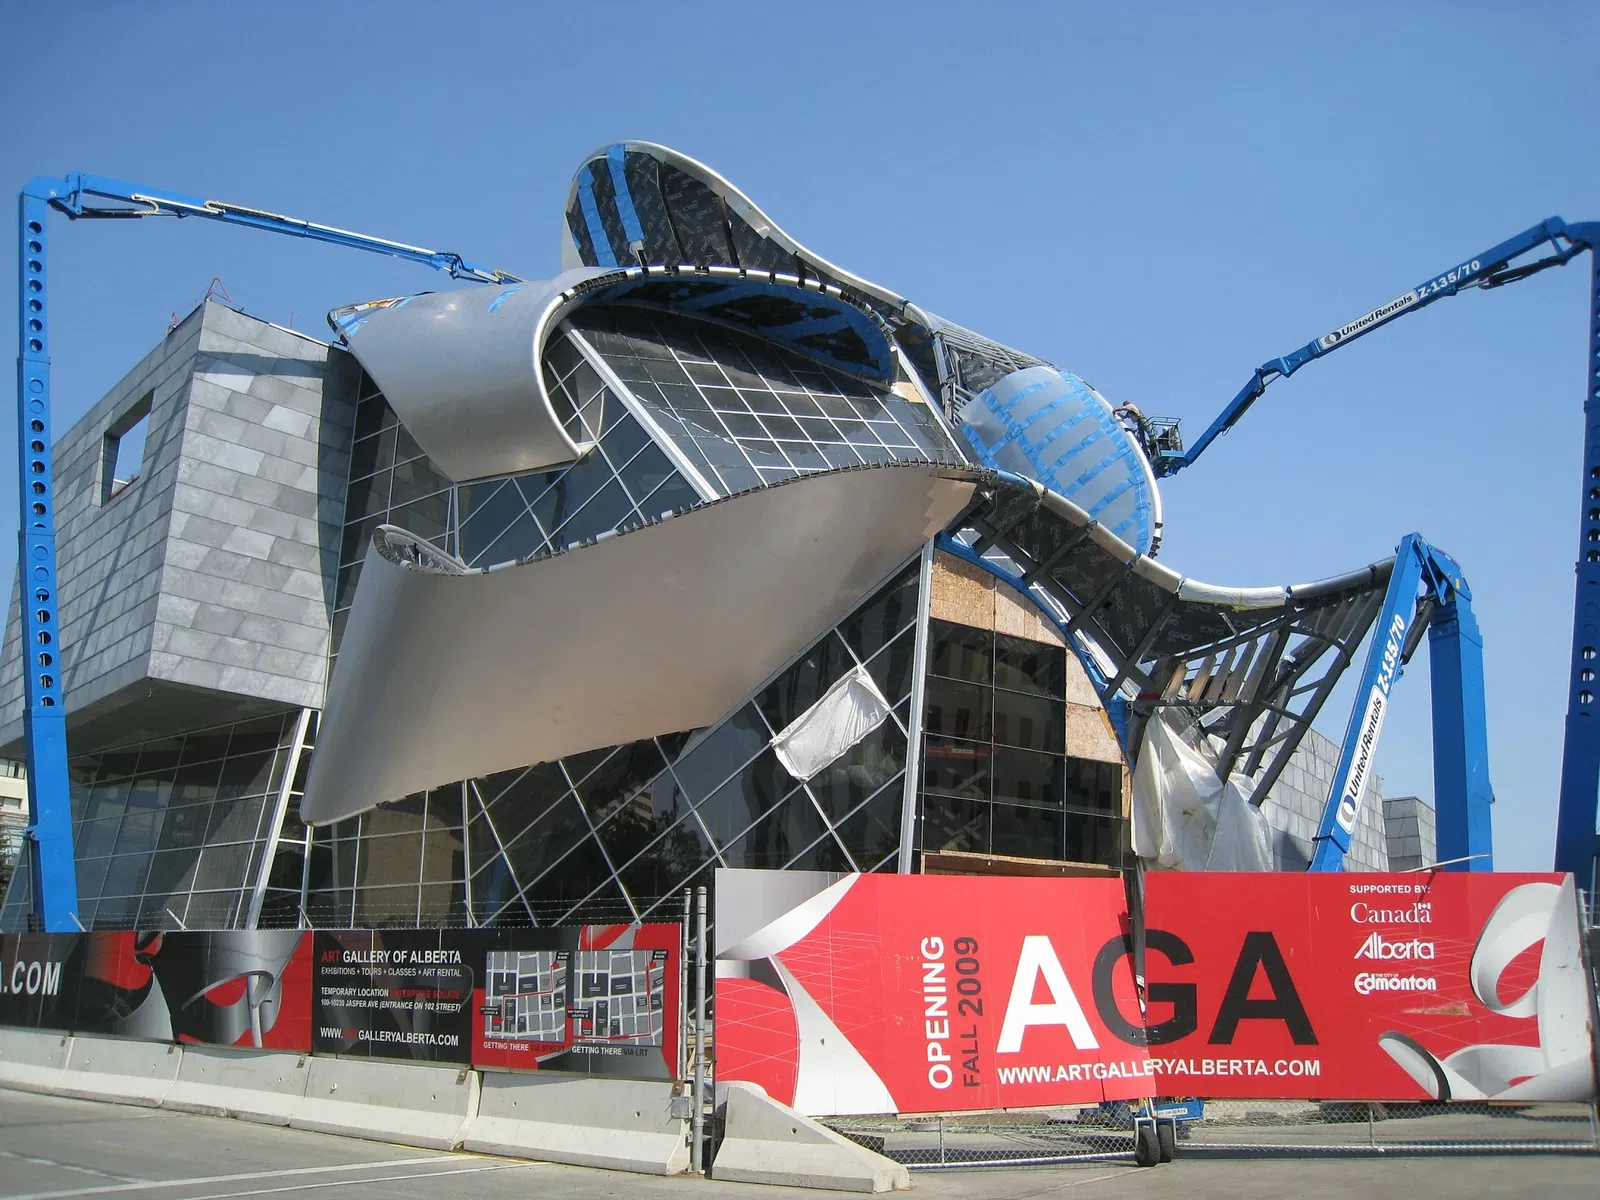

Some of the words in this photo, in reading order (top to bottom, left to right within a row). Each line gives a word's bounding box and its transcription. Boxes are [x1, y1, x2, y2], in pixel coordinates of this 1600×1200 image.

[1341, 310, 1375, 337] United
[1375, 293, 1413, 319] Rentals
[1417, 259, 1481, 299] Z-135/70
[1350, 745, 1369, 796] United
[1362, 697, 1382, 749] Rentals
[1376, 613, 1406, 695] Z-135/70
[1349, 884, 1411, 894] SUPPORTED
[1414, 884, 1431, 894] BY:
[1350, 902, 1432, 924] Canada
[1353, 931, 1435, 960] Alberta
[321, 950, 341, 963] ART
[343, 950, 391, 963] GALLERY
[393, 950, 408, 963] OF
[410, 950, 461, 964] ALBERTA
[321, 966, 355, 976] EXHIBITIONS
[362, 967, 382, 976] TOURS
[388, 968, 416, 976] CLASSES
[422, 968, 436, 976] ART
[437, 968, 461, 977] RENTAL
[953, 936, 983, 1017] 2009
[321, 987, 357, 996] TEMPORARY
[357, 988, 389, 997] LOCATION
[996, 929, 1319, 1053] AGA
[1354, 972, 1437, 995] Edmonton
[345, 999, 367, 1007] JASPER
[368, 1000, 379, 1008] AVE
[380, 1001, 413, 1009] (ENTRANCE
[414, 1002, 423, 1010] ON
[424, 1002, 434, 1010] 102
[920, 936, 953, 1089] OPENING
[320, 1026, 459, 1046] WWW.GALLERYALBERTA.COM
[483, 1041, 508, 1050] GETTING
[509, 1042, 529, 1051] THERE
[572, 1045, 599, 1055] GETTING
[601, 1046, 622, 1056] THERE
[624, 1048, 634, 1056] VIA
[635, 1048, 648, 1057] LRT
[960, 1024, 980, 1088] FALL
[997, 1058, 1321, 1085] WWW.ARTGALLERYALBERTA.COM
